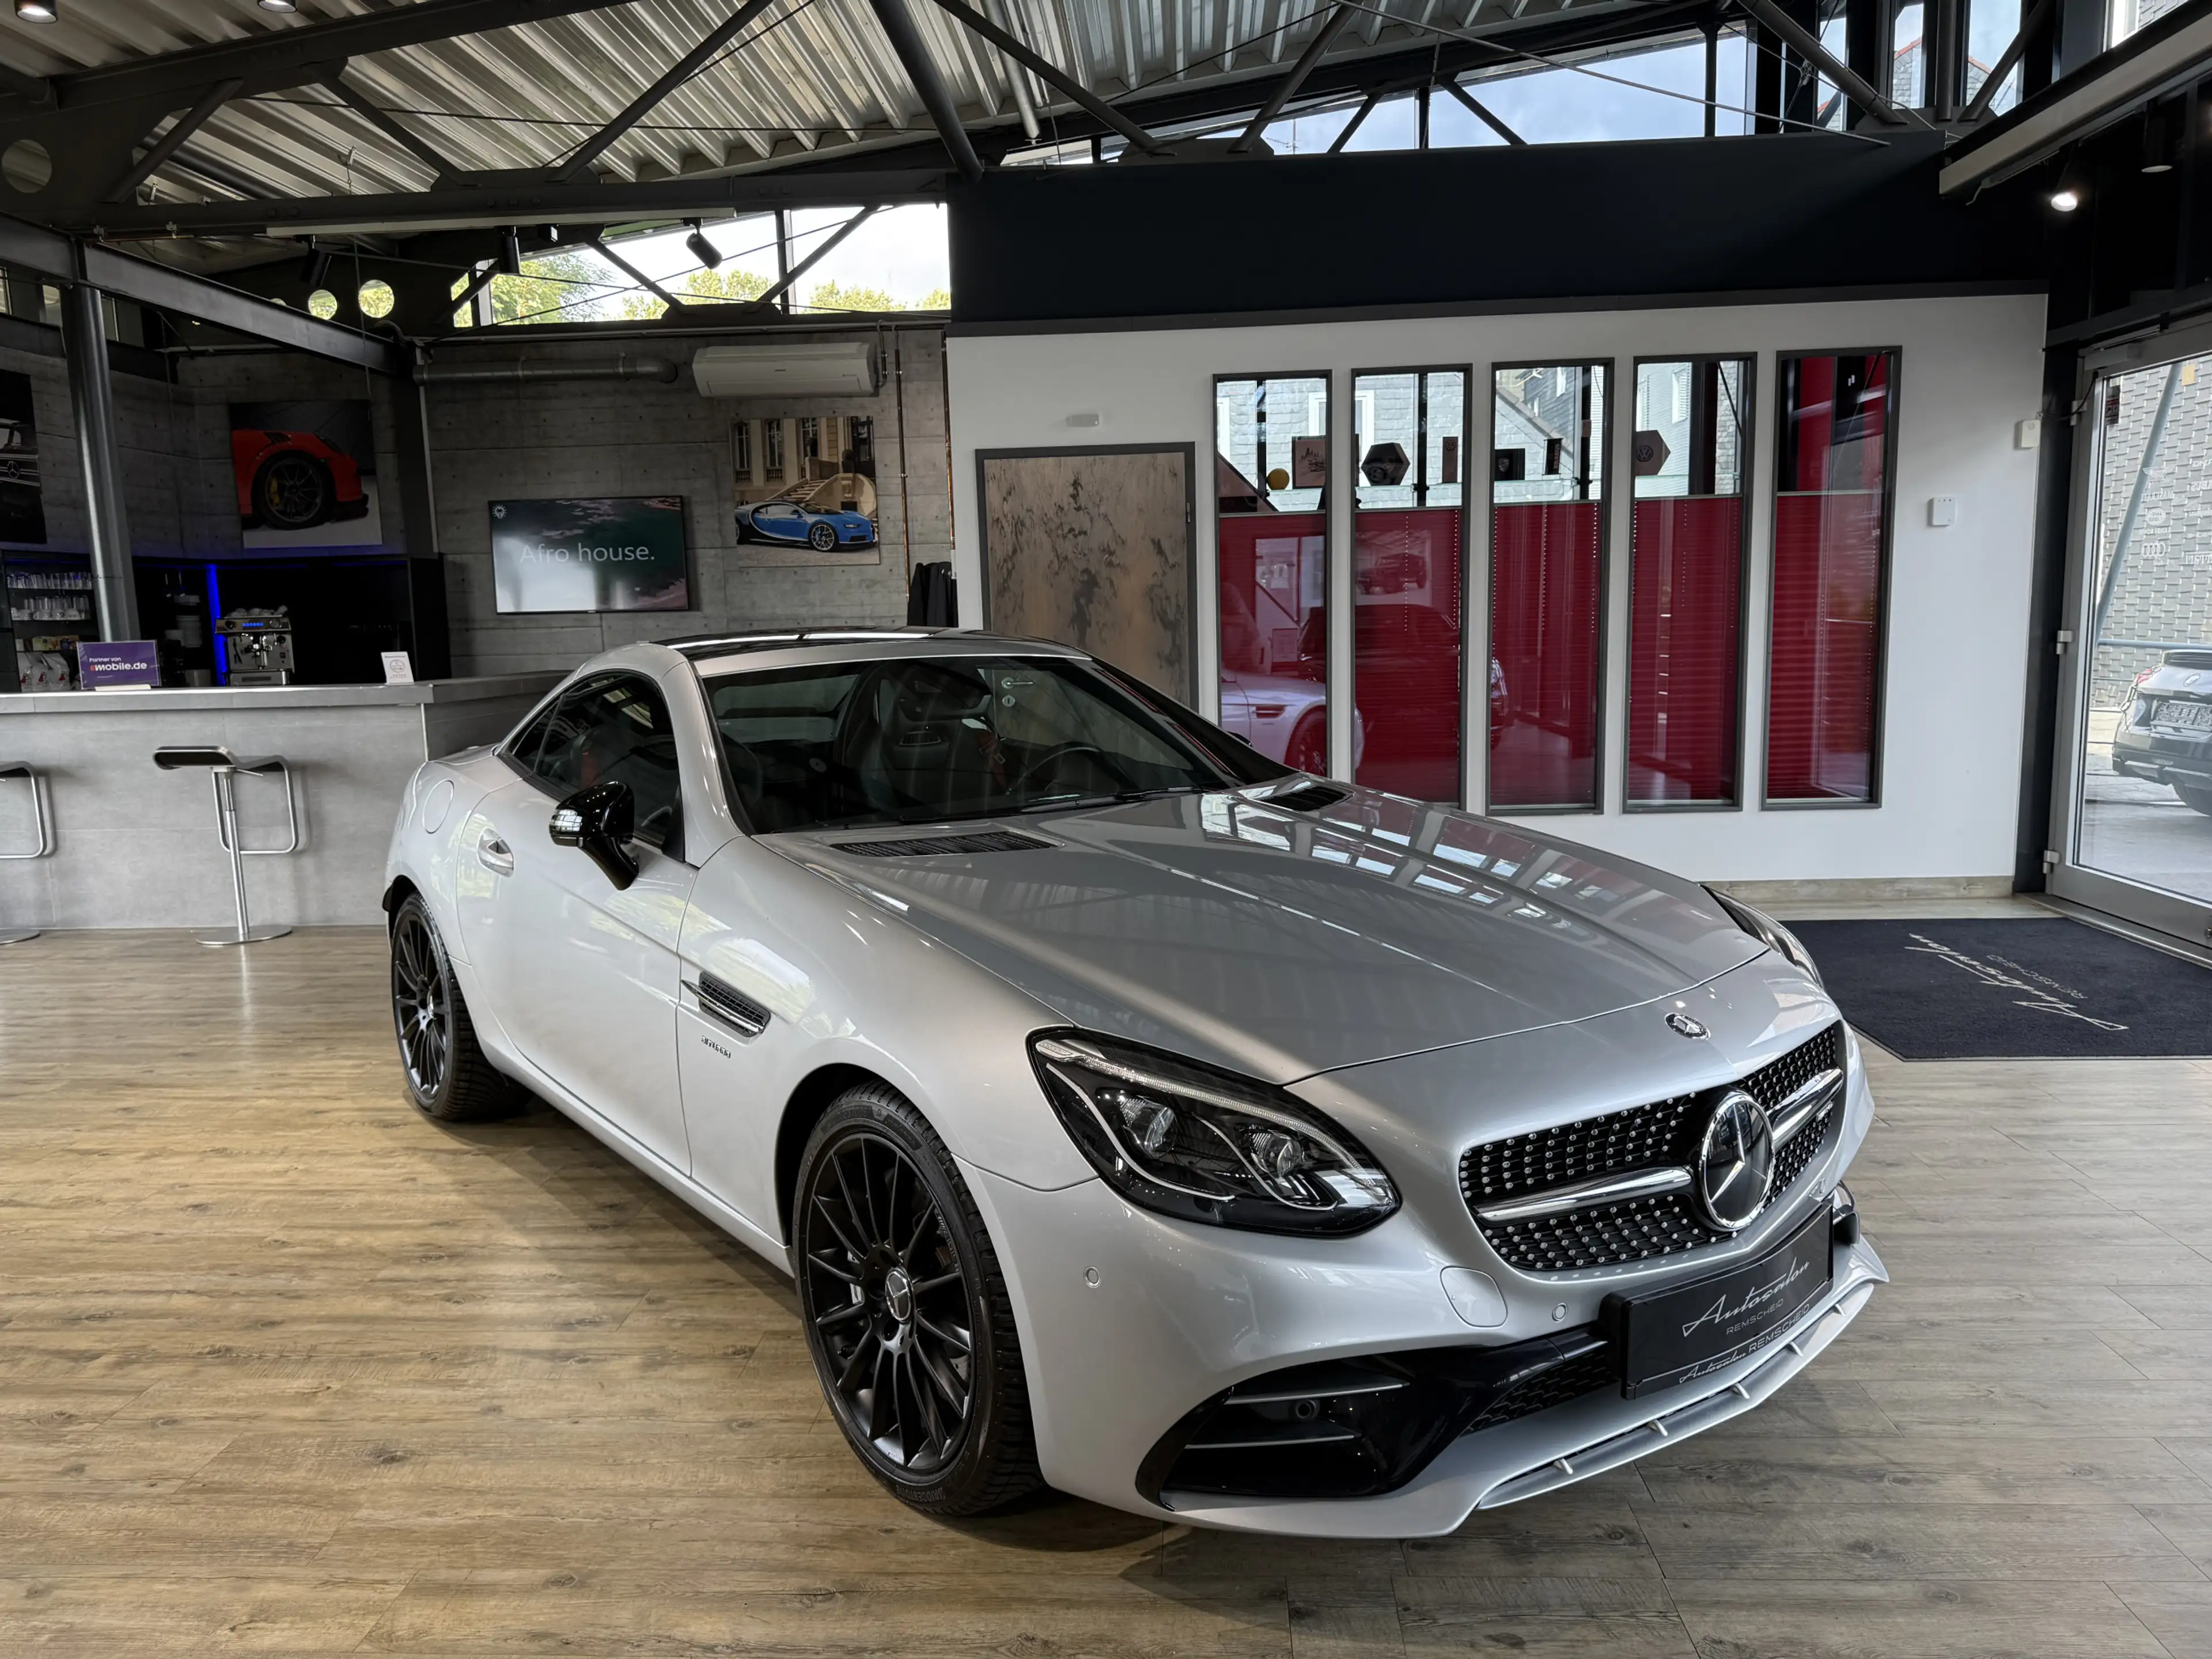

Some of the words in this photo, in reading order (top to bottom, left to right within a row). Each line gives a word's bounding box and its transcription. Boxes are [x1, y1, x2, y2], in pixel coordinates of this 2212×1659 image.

[519, 543, 569, 564] Afro
[578, 542, 655, 562] house.
[94, 662, 147, 671] mobile.de
[1904, 933, 2130, 1031] Autosalon
[1682, 1256, 1810, 1337] Autosalon
[1726, 1298, 1785, 1335] REMSCHEID
[1679, 1351, 1747, 1384] Autosalon
[1748, 1304, 1810, 1354] REMSCHEID
[895, 1484, 946, 1502] BRIDGESTONE
